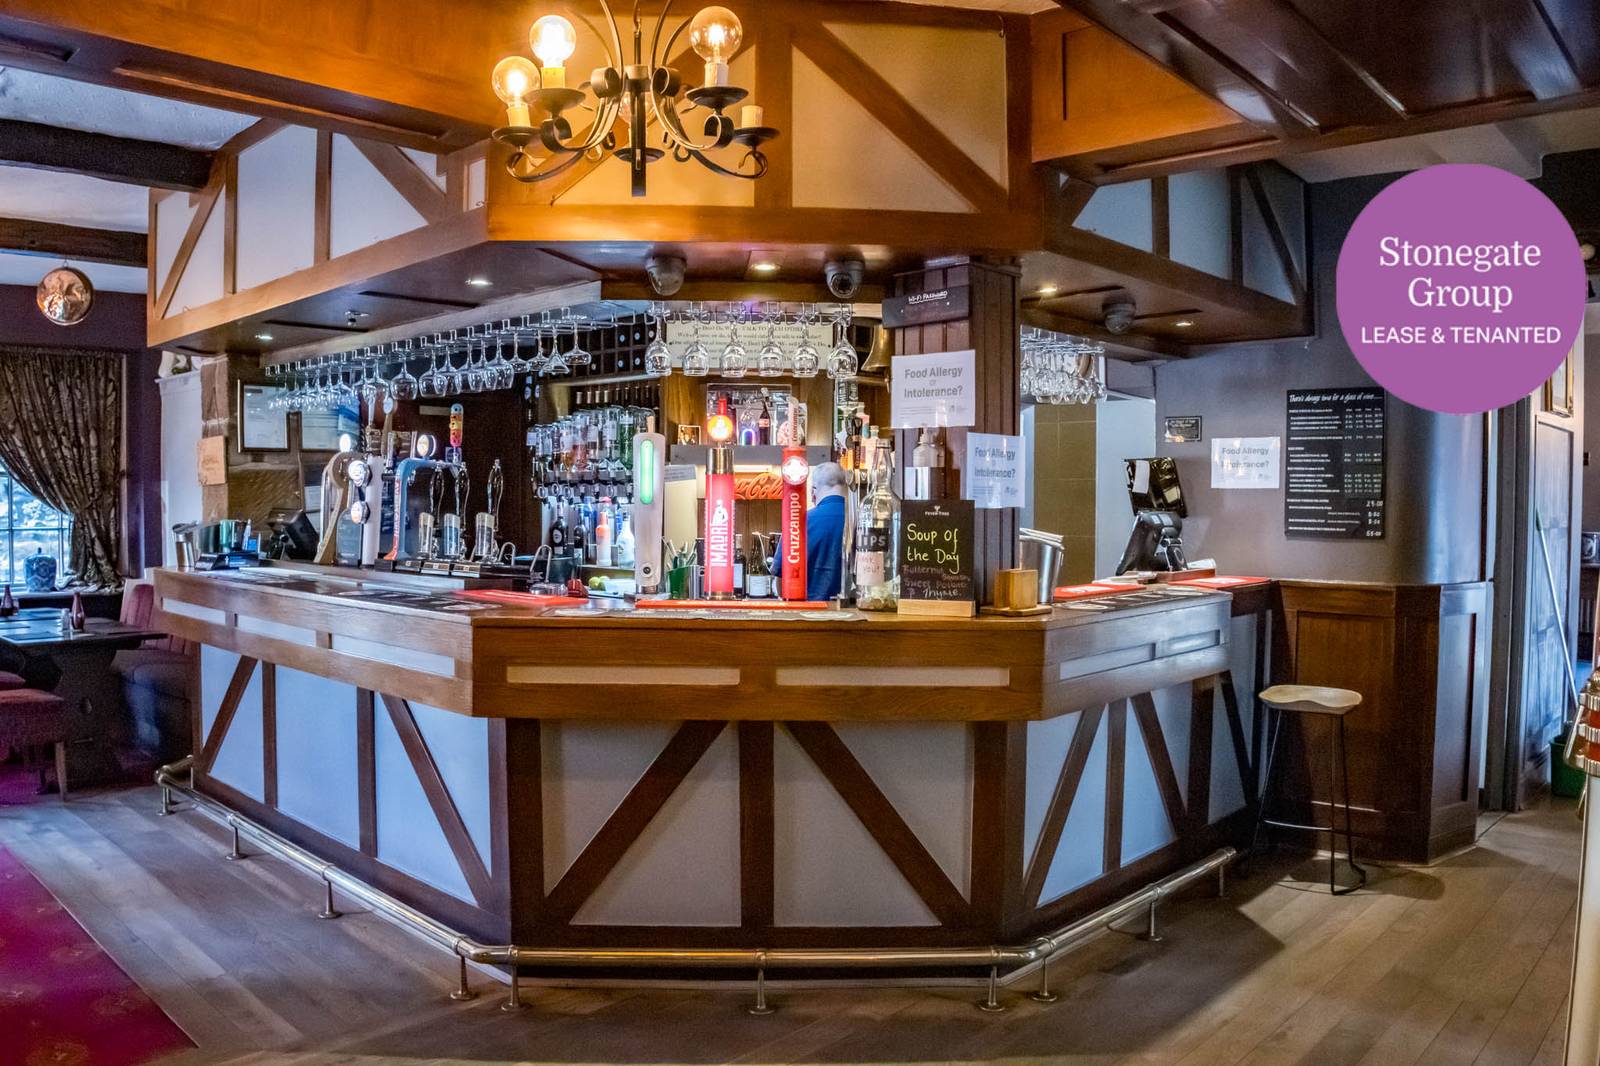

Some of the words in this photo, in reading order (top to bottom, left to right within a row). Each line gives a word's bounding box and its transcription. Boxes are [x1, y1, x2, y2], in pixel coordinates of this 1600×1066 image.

[905, 368, 927, 379] Food
[929, 367, 963, 379] Allergy
[904, 386, 963, 398] Intolerance?
[1222, 447, 1241, 455] Food
[1242, 447, 1270, 456] Allergy
[1221, 460, 1270, 469] Iolrance?
[787, 492, 800, 564] Cruzcampo
[907, 523, 938, 544] Soup
[907, 546, 929, 562] the
[935, 548, 960, 575] Day
